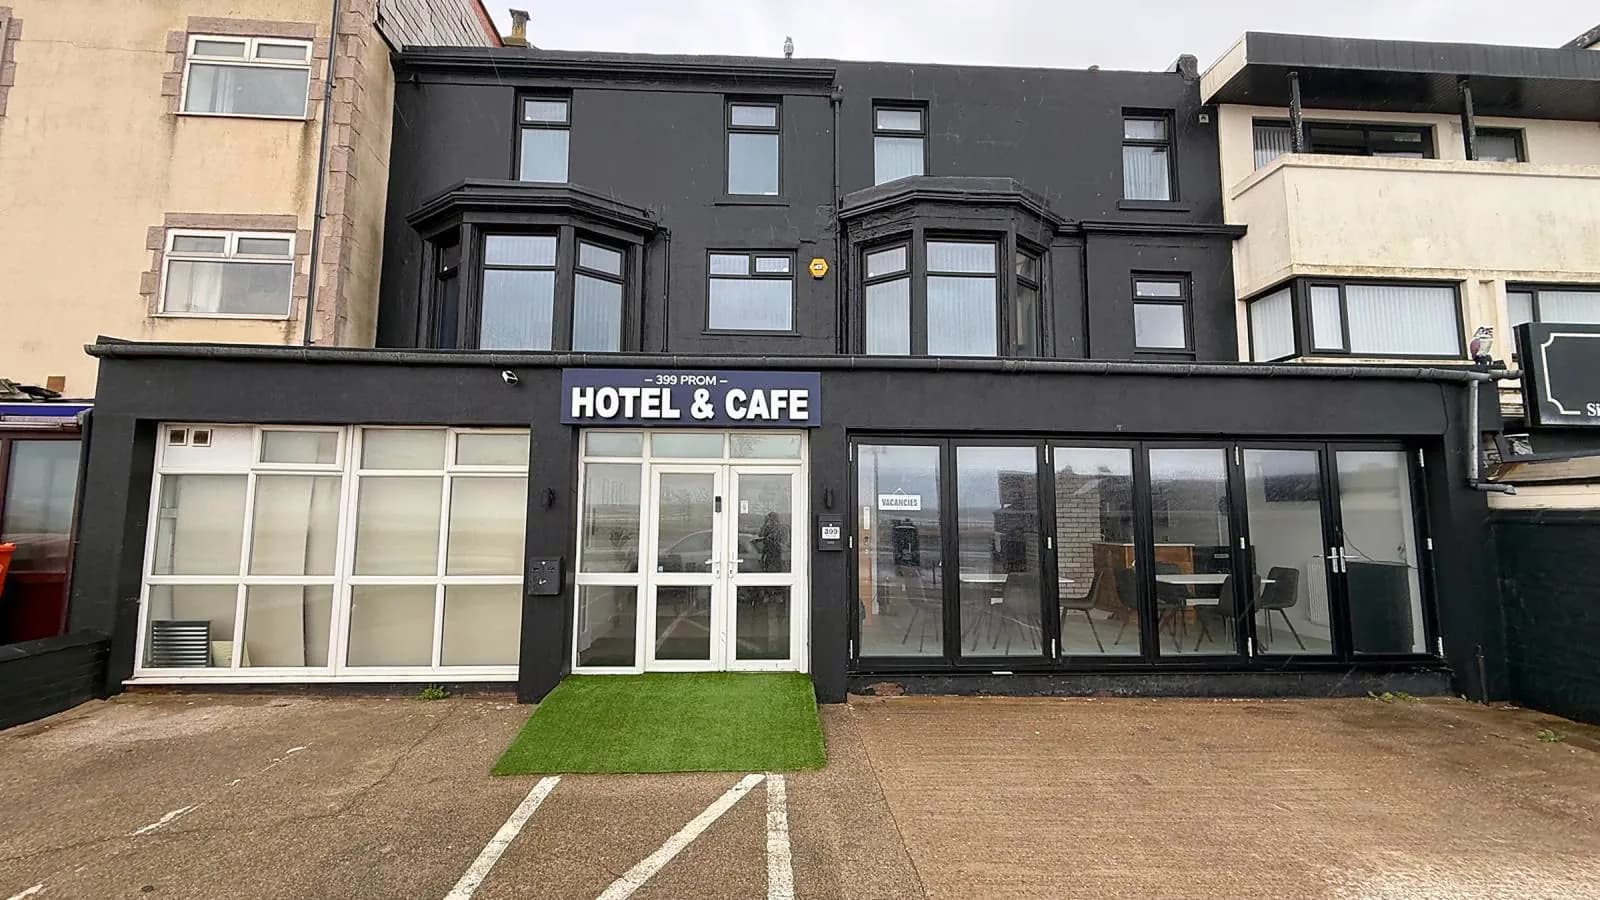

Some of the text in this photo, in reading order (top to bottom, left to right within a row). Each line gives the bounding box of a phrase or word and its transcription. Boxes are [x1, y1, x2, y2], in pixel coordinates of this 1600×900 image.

[655, 374, 717, 386] 399 PROM
[571, 386, 809, 420] HOTEL & CAFE
[881, 498, 919, 507] VACANCIES
